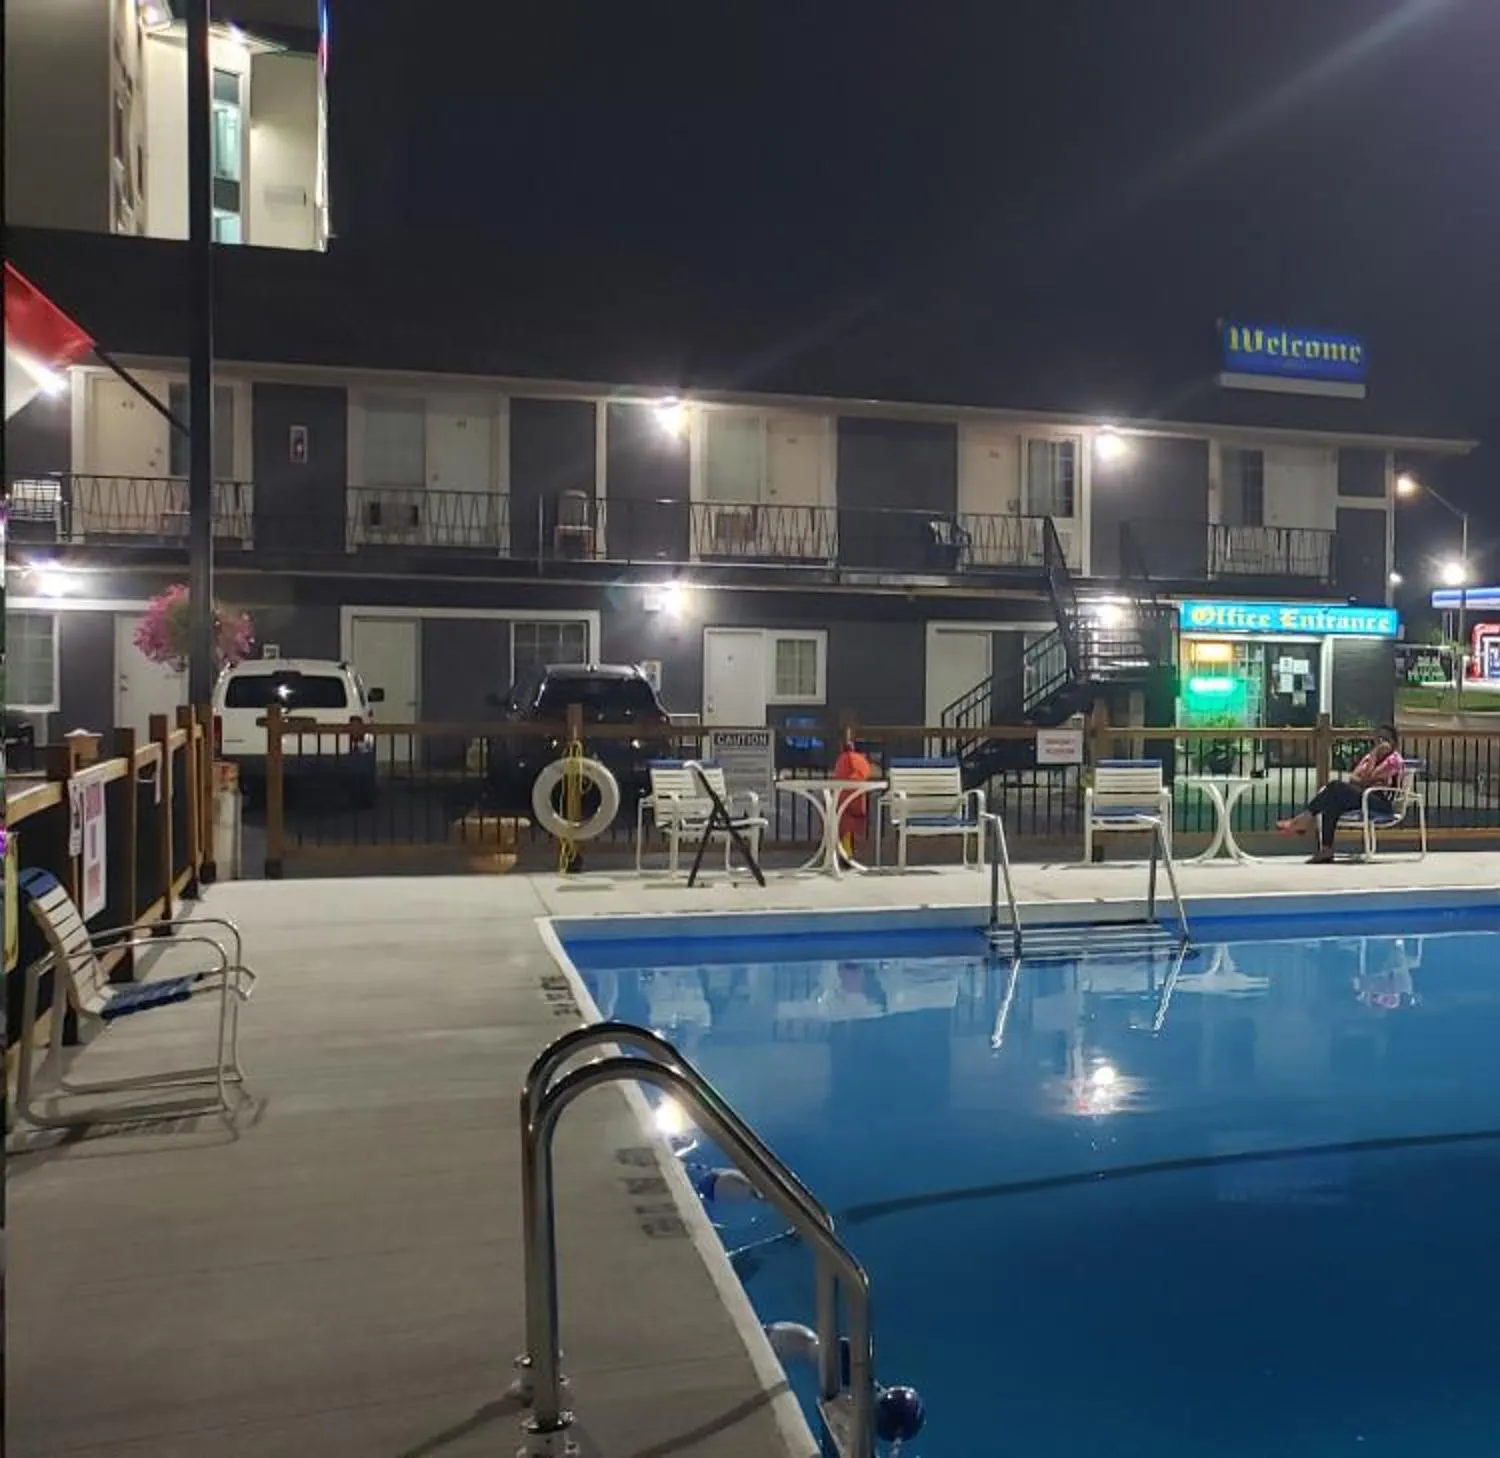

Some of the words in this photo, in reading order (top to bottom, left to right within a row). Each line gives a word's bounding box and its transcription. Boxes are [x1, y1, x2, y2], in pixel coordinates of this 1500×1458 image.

[1229, 325, 1362, 365] Welcome
[1190, 605, 1271, 627] Office
[1279, 607, 1391, 630] Entrance
[717, 734, 767, 745] CAUTION
